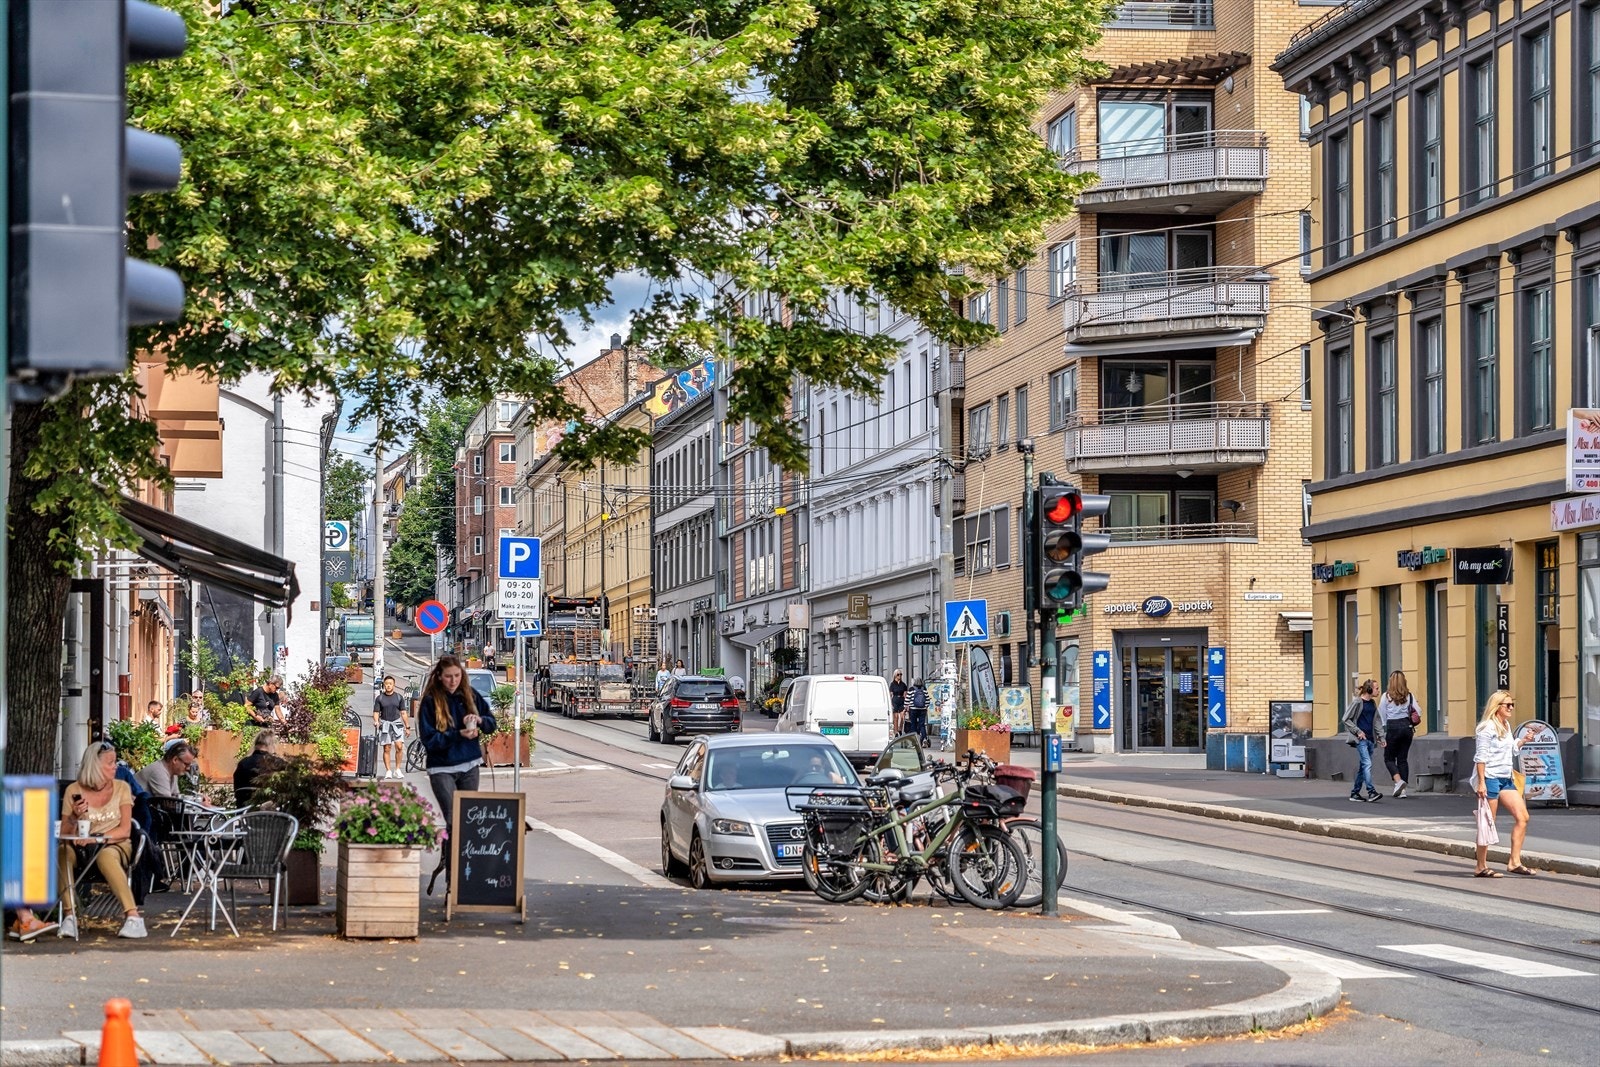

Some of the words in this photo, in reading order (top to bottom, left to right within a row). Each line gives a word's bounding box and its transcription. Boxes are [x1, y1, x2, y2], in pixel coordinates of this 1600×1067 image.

[509, 542, 531, 573] P
[1458, 560, 1470, 570] Oh
[1469, 562, 1482, 574] my
[851, 595, 865, 613] F
[1104, 602, 1138, 614] apotek
[1144, 599, 1168, 613] Boots
[1178, 600, 1213, 612] apotek
[914, 634, 938, 643] Normal
[1498, 606, 1509, 686] FRISØR
